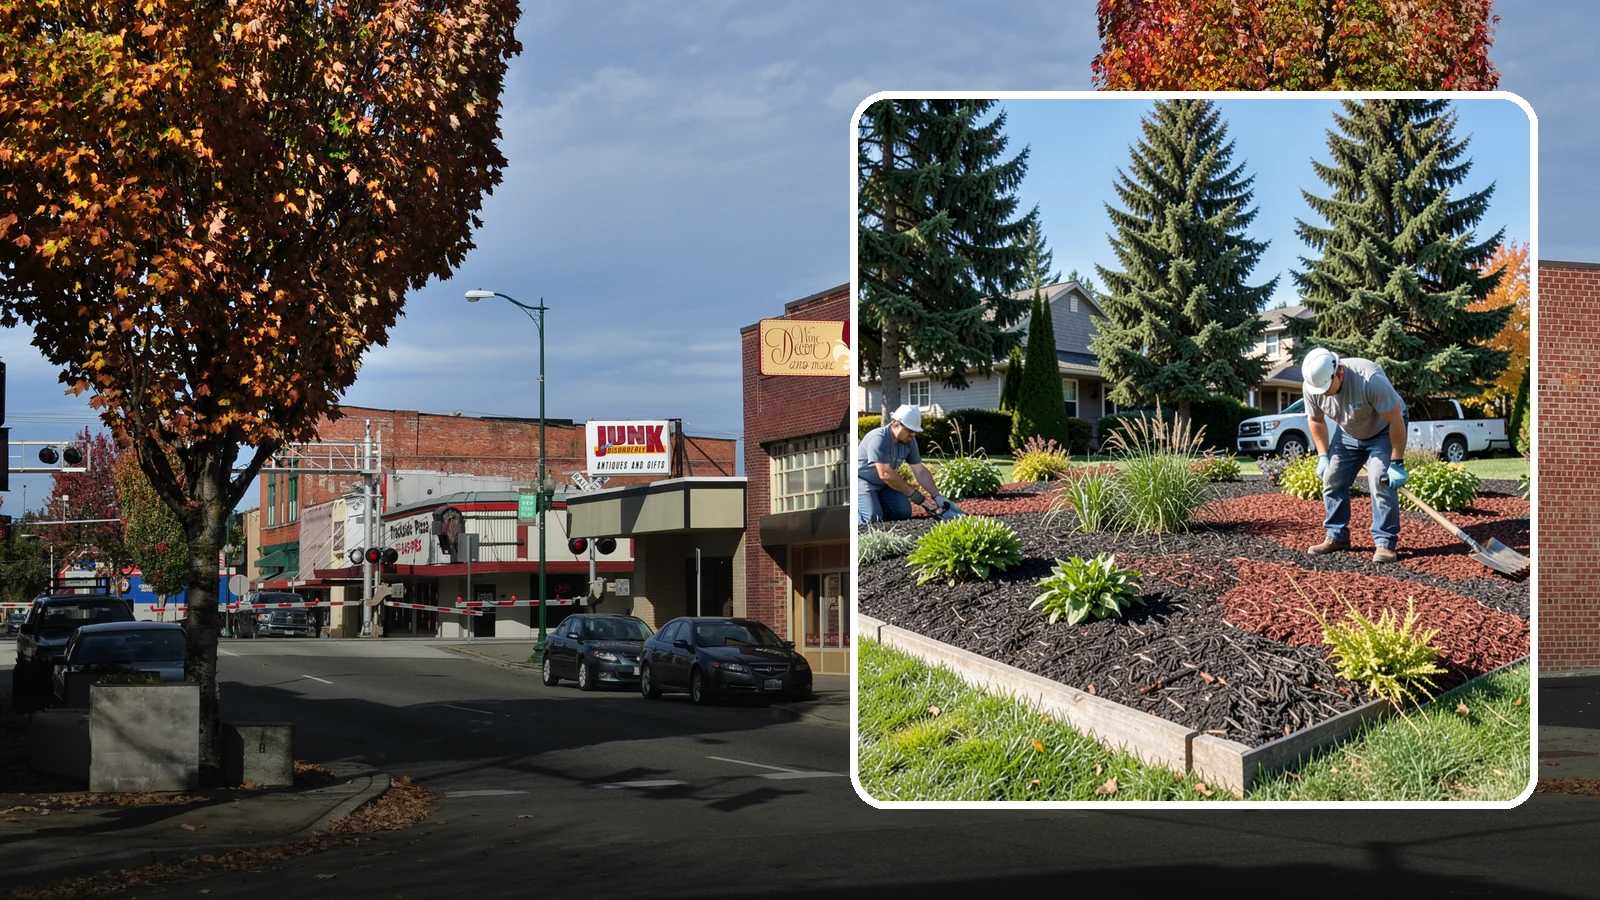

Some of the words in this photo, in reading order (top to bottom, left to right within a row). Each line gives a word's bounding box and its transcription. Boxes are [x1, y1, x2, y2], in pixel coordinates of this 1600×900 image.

[596, 425, 665, 457] JUNK
[607, 446, 646, 454] DISORDERLY
[597, 461, 628, 470] ANTIQUES
[631, 461, 644, 469] AND
[647, 460, 665, 469] GIFTS
[573, 474, 588, 490] RAIL
[390, 521, 413, 540] Trackside
[414, 519, 429, 535] Pizza
